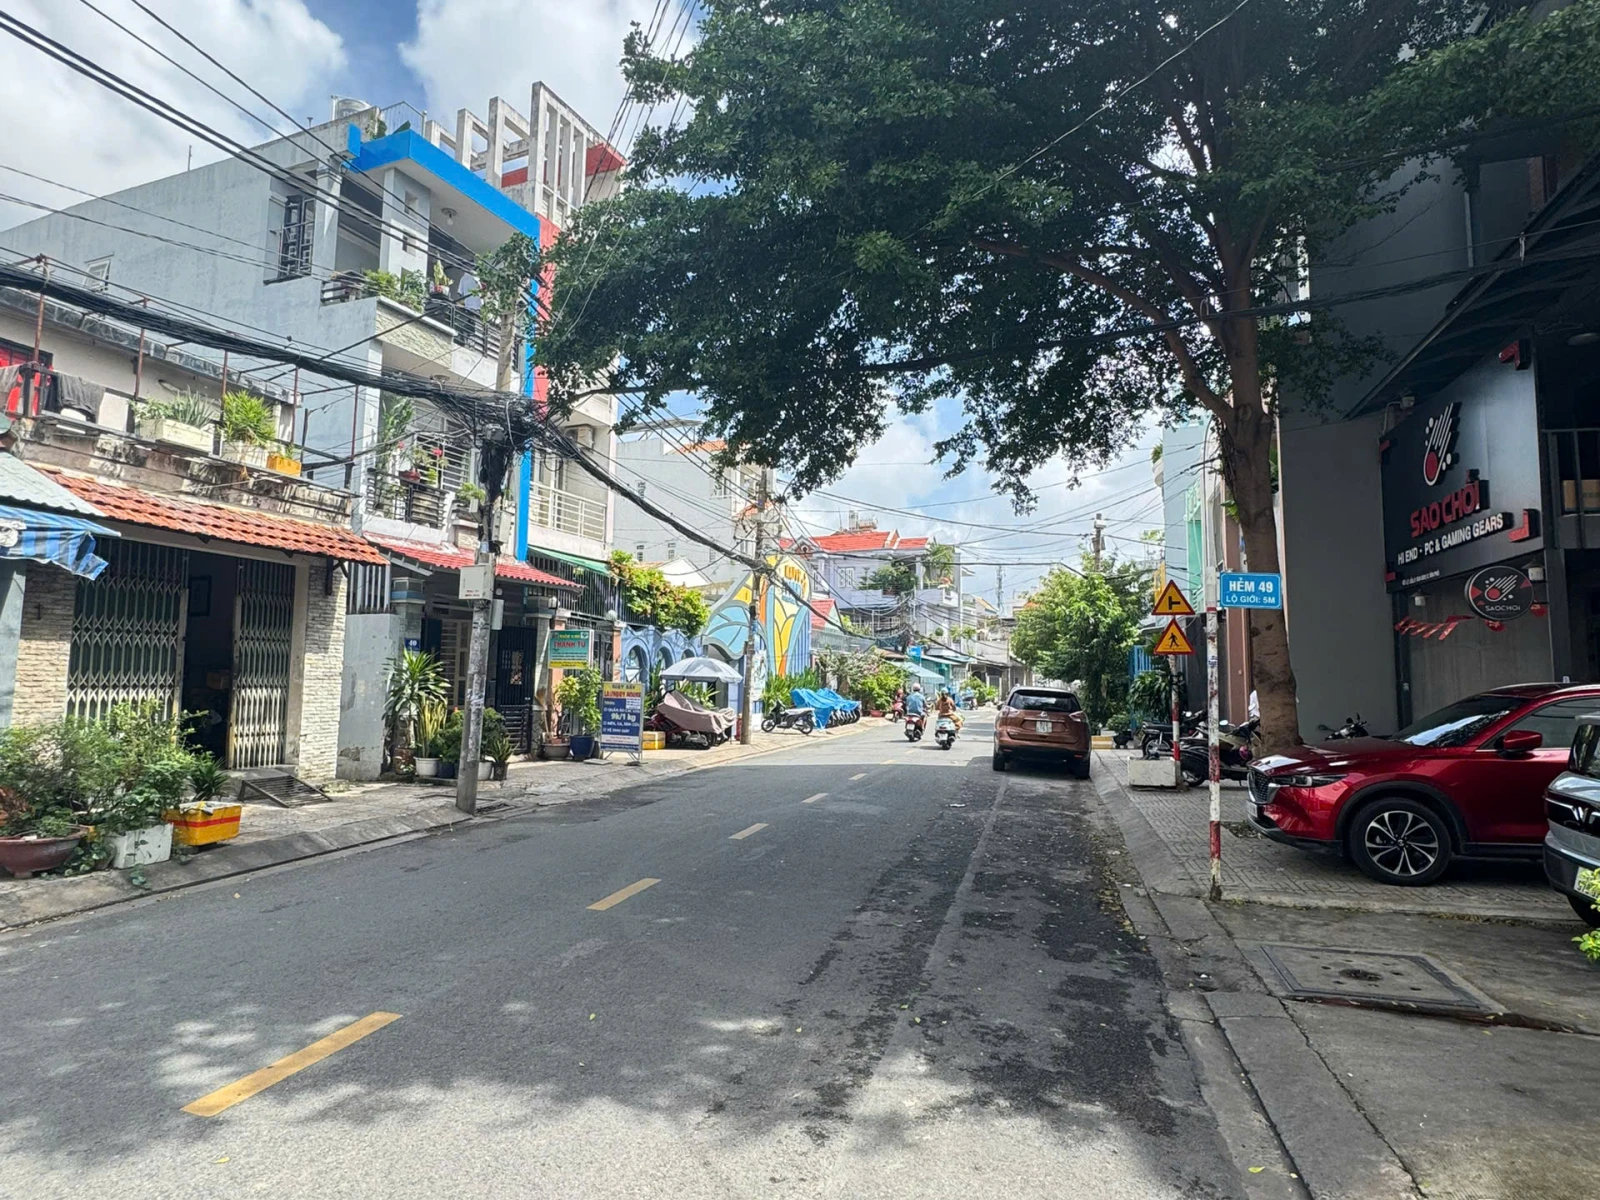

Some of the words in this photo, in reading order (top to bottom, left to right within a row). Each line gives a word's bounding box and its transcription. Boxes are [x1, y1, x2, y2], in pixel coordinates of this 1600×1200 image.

[1410, 501, 1440, 538] SAO
[1398, 552, 1405, 565] HI
[1406, 547, 1418, 563] END
[1424, 541, 1434, 556] PC
[1435, 538, 1441, 552] &
[1441, 525, 1471, 549] GAMING
[1473, 513, 1504, 538] GEARS
[1229, 577, 1255, 593] HẺM
[1258, 581, 1273, 593] 49
[1226, 594, 1237, 604] LỘ
[1240, 594, 1262, 604] GIỚI:
[611, 713, 626, 721] 9k/1
[627, 714, 636, 722] kg
